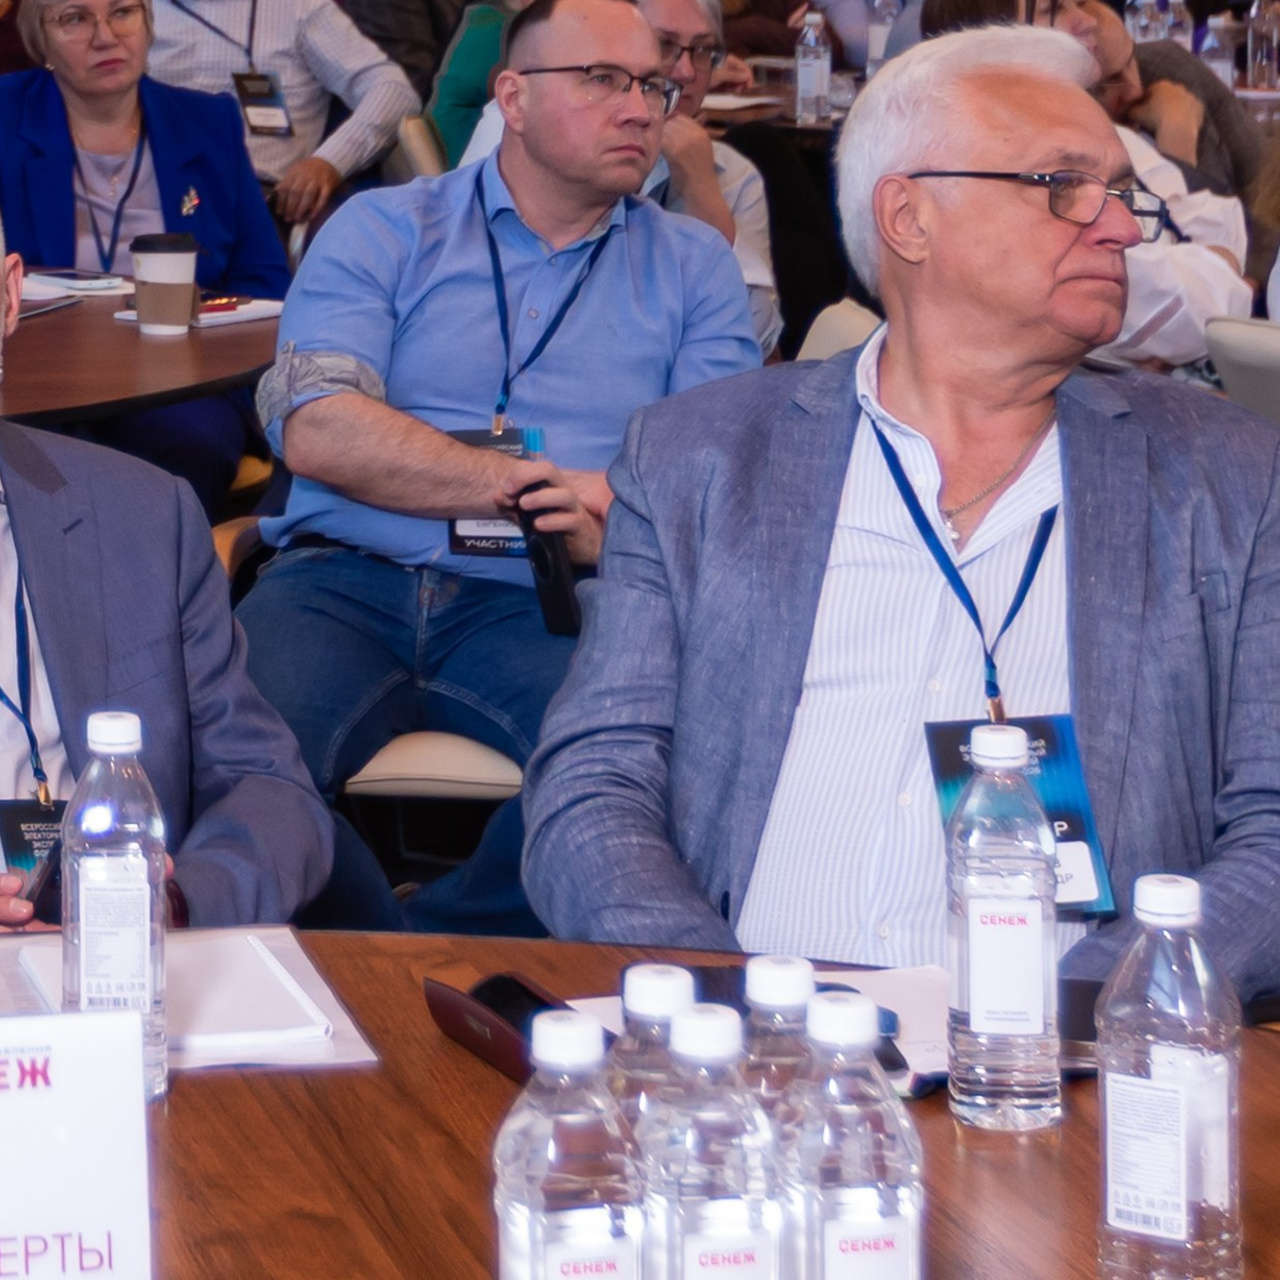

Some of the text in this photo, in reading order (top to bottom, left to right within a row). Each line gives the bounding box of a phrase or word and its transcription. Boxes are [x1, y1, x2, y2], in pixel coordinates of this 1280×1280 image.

[465, 539, 527, 549] УЧАСТНИ
[980, 914, 1028, 926] СЕНЕЖ
[838, 1237, 896, 1253] СЕНЕЖ
[698, 1251, 756, 1267] СЕНЕЖ
[560, 1260, 619, 1277] СЕНЕЖ
